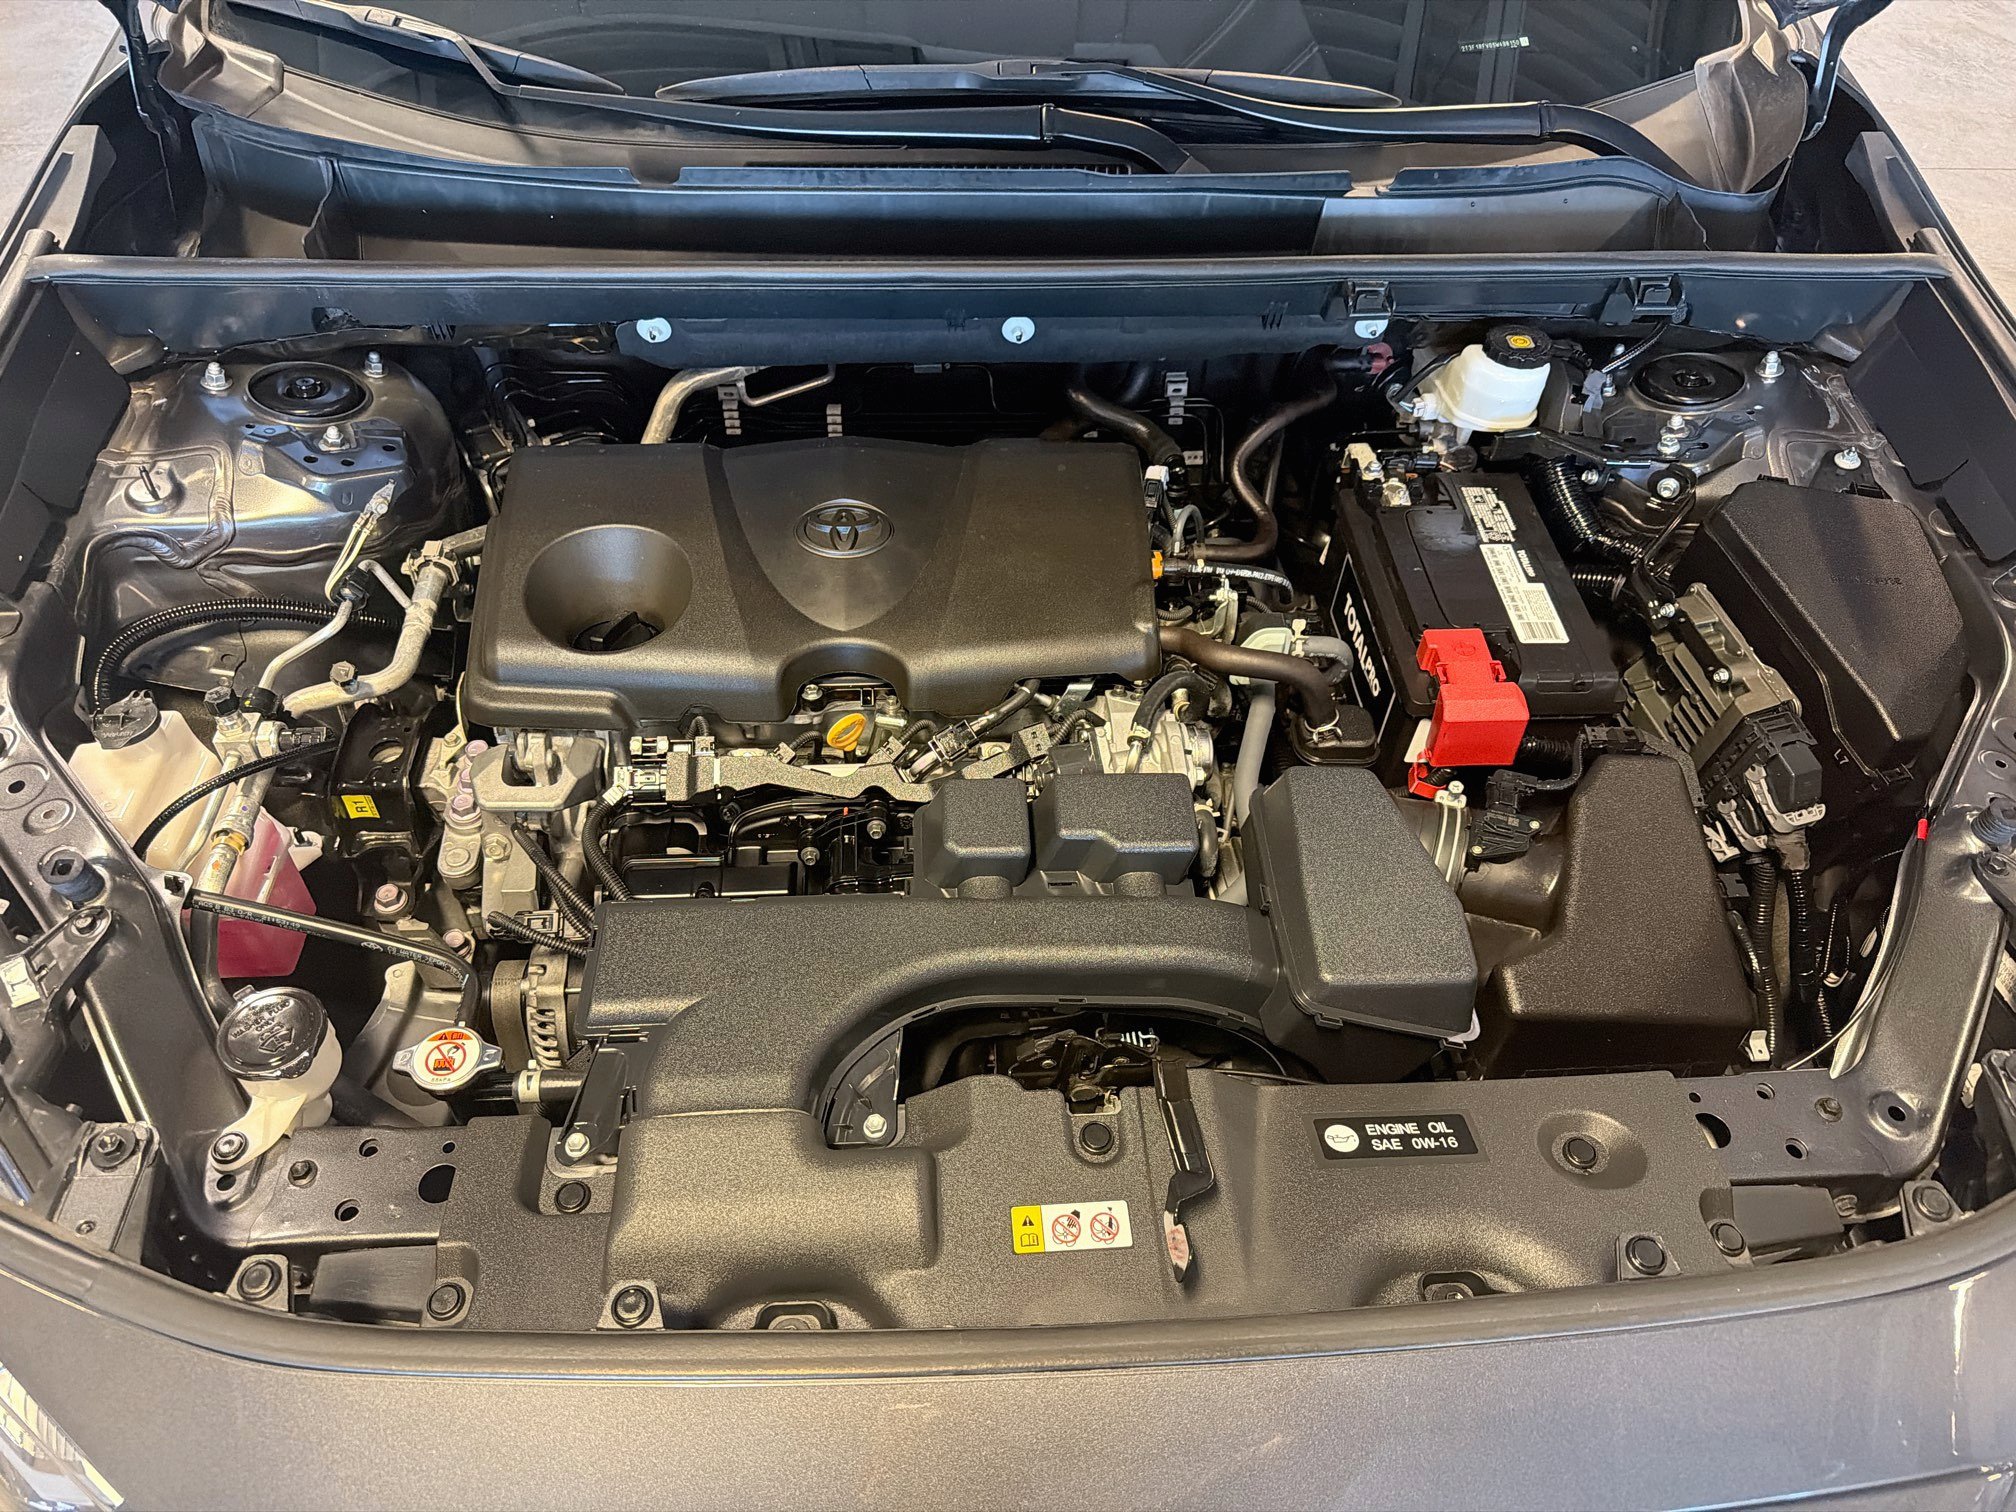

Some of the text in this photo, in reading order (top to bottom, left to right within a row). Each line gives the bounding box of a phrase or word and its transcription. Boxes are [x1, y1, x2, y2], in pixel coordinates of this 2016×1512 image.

[1344, 592, 1381, 697] TOTALPRO
[351, 800, 369, 813] R1
[1364, 1121, 1454, 1136] ENGINE OIL
[1371, 1136, 1459, 1151] SAE 0W-16
